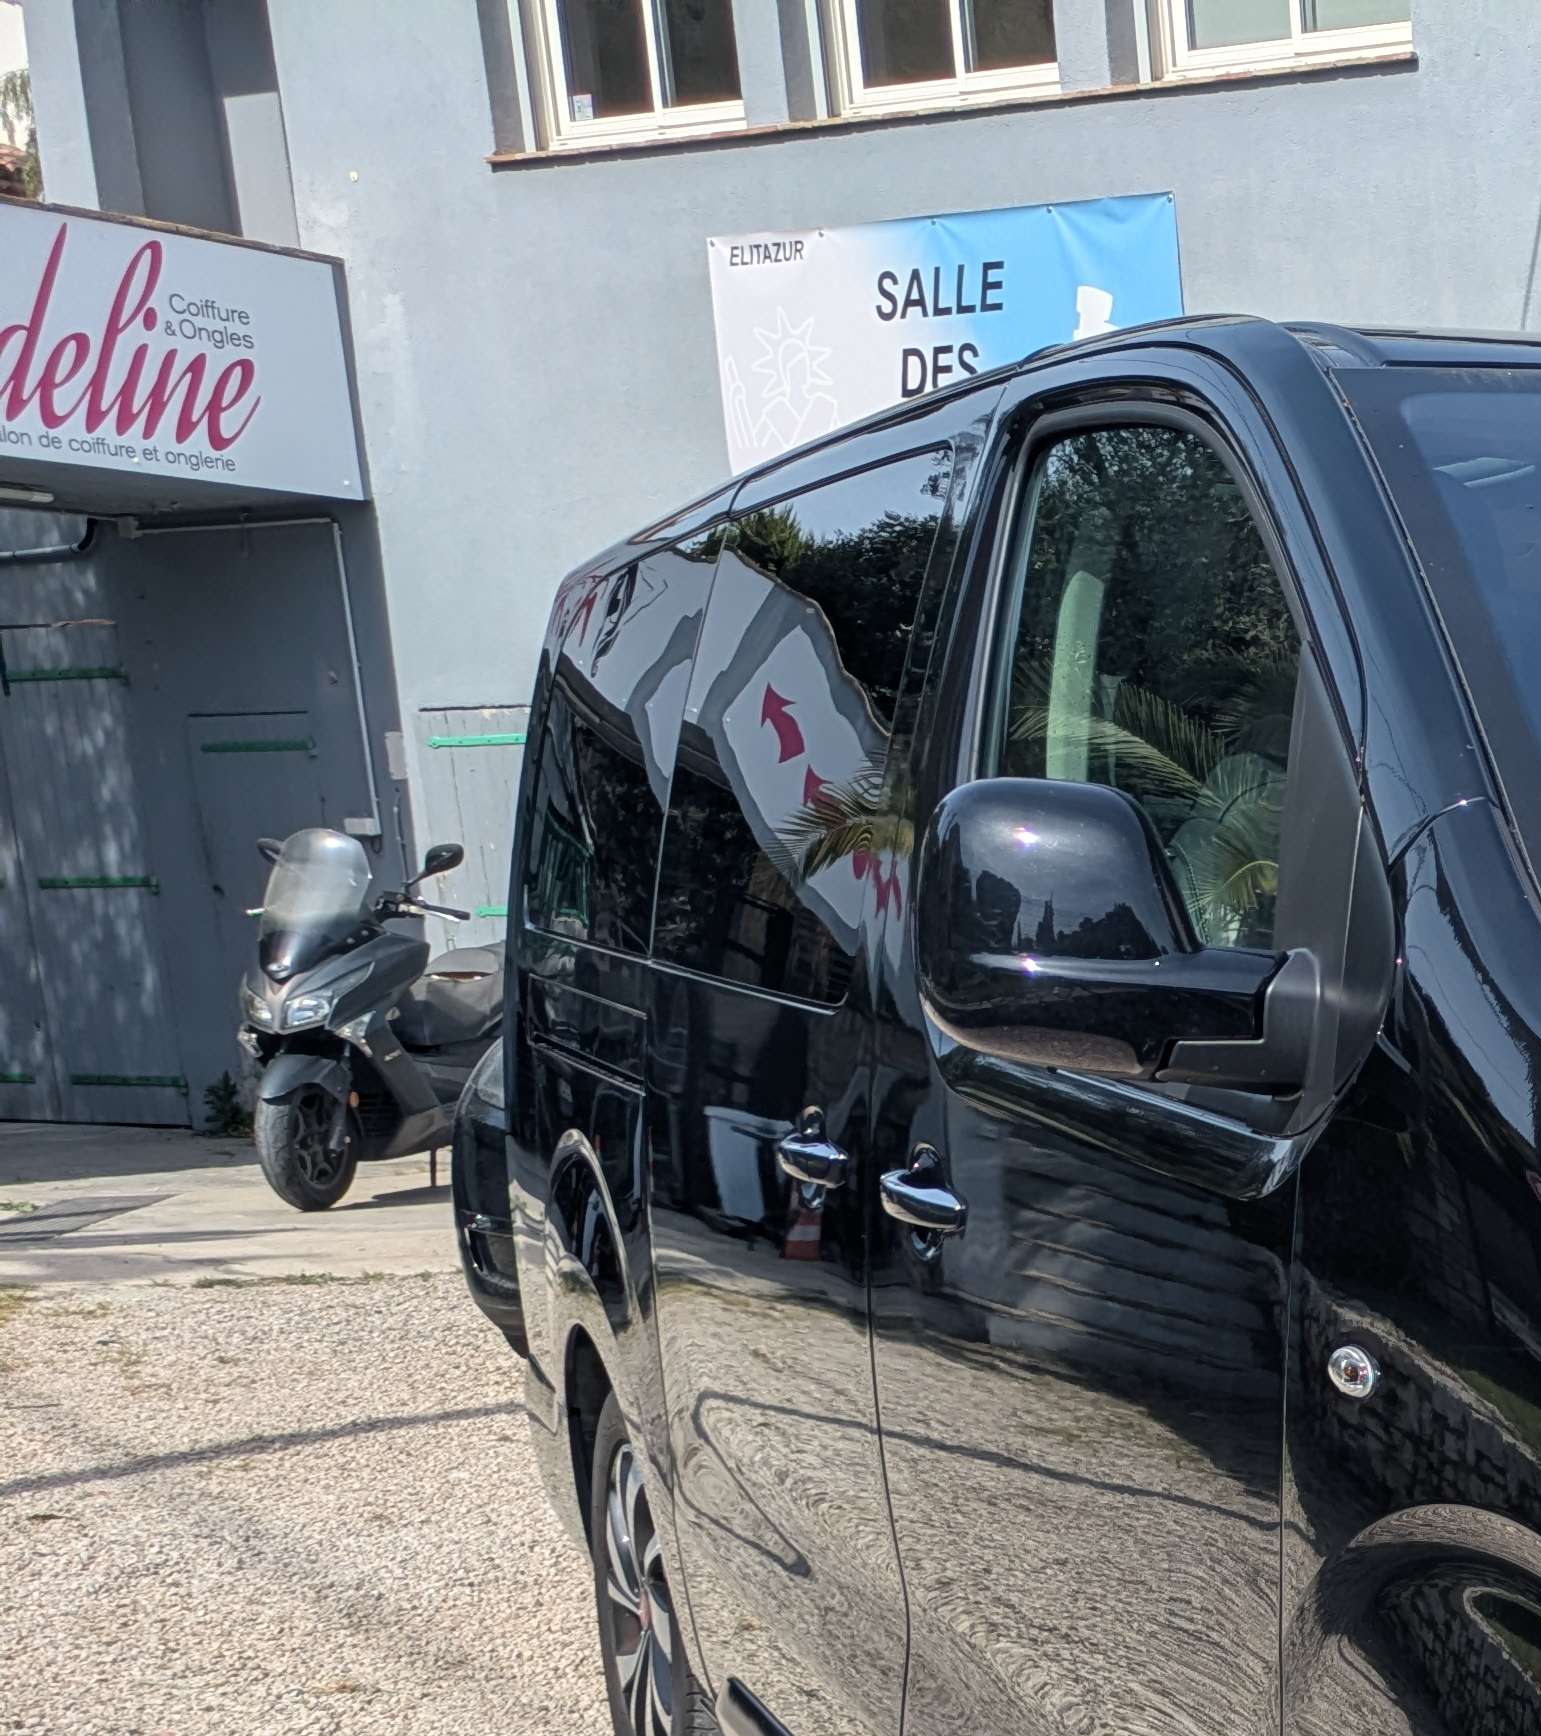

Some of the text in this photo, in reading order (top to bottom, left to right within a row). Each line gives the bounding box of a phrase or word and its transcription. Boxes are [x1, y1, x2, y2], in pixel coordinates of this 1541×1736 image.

[729, 239, 805, 267] ELITAZUR
[168, 292, 251, 326] Coiffure
[875, 260, 1006, 322] SALLE
[38, 429, 63, 450] de
[68, 437, 137, 460] coiffure
[142, 446, 161, 463] et
[165, 450, 237, 472] onglerie
